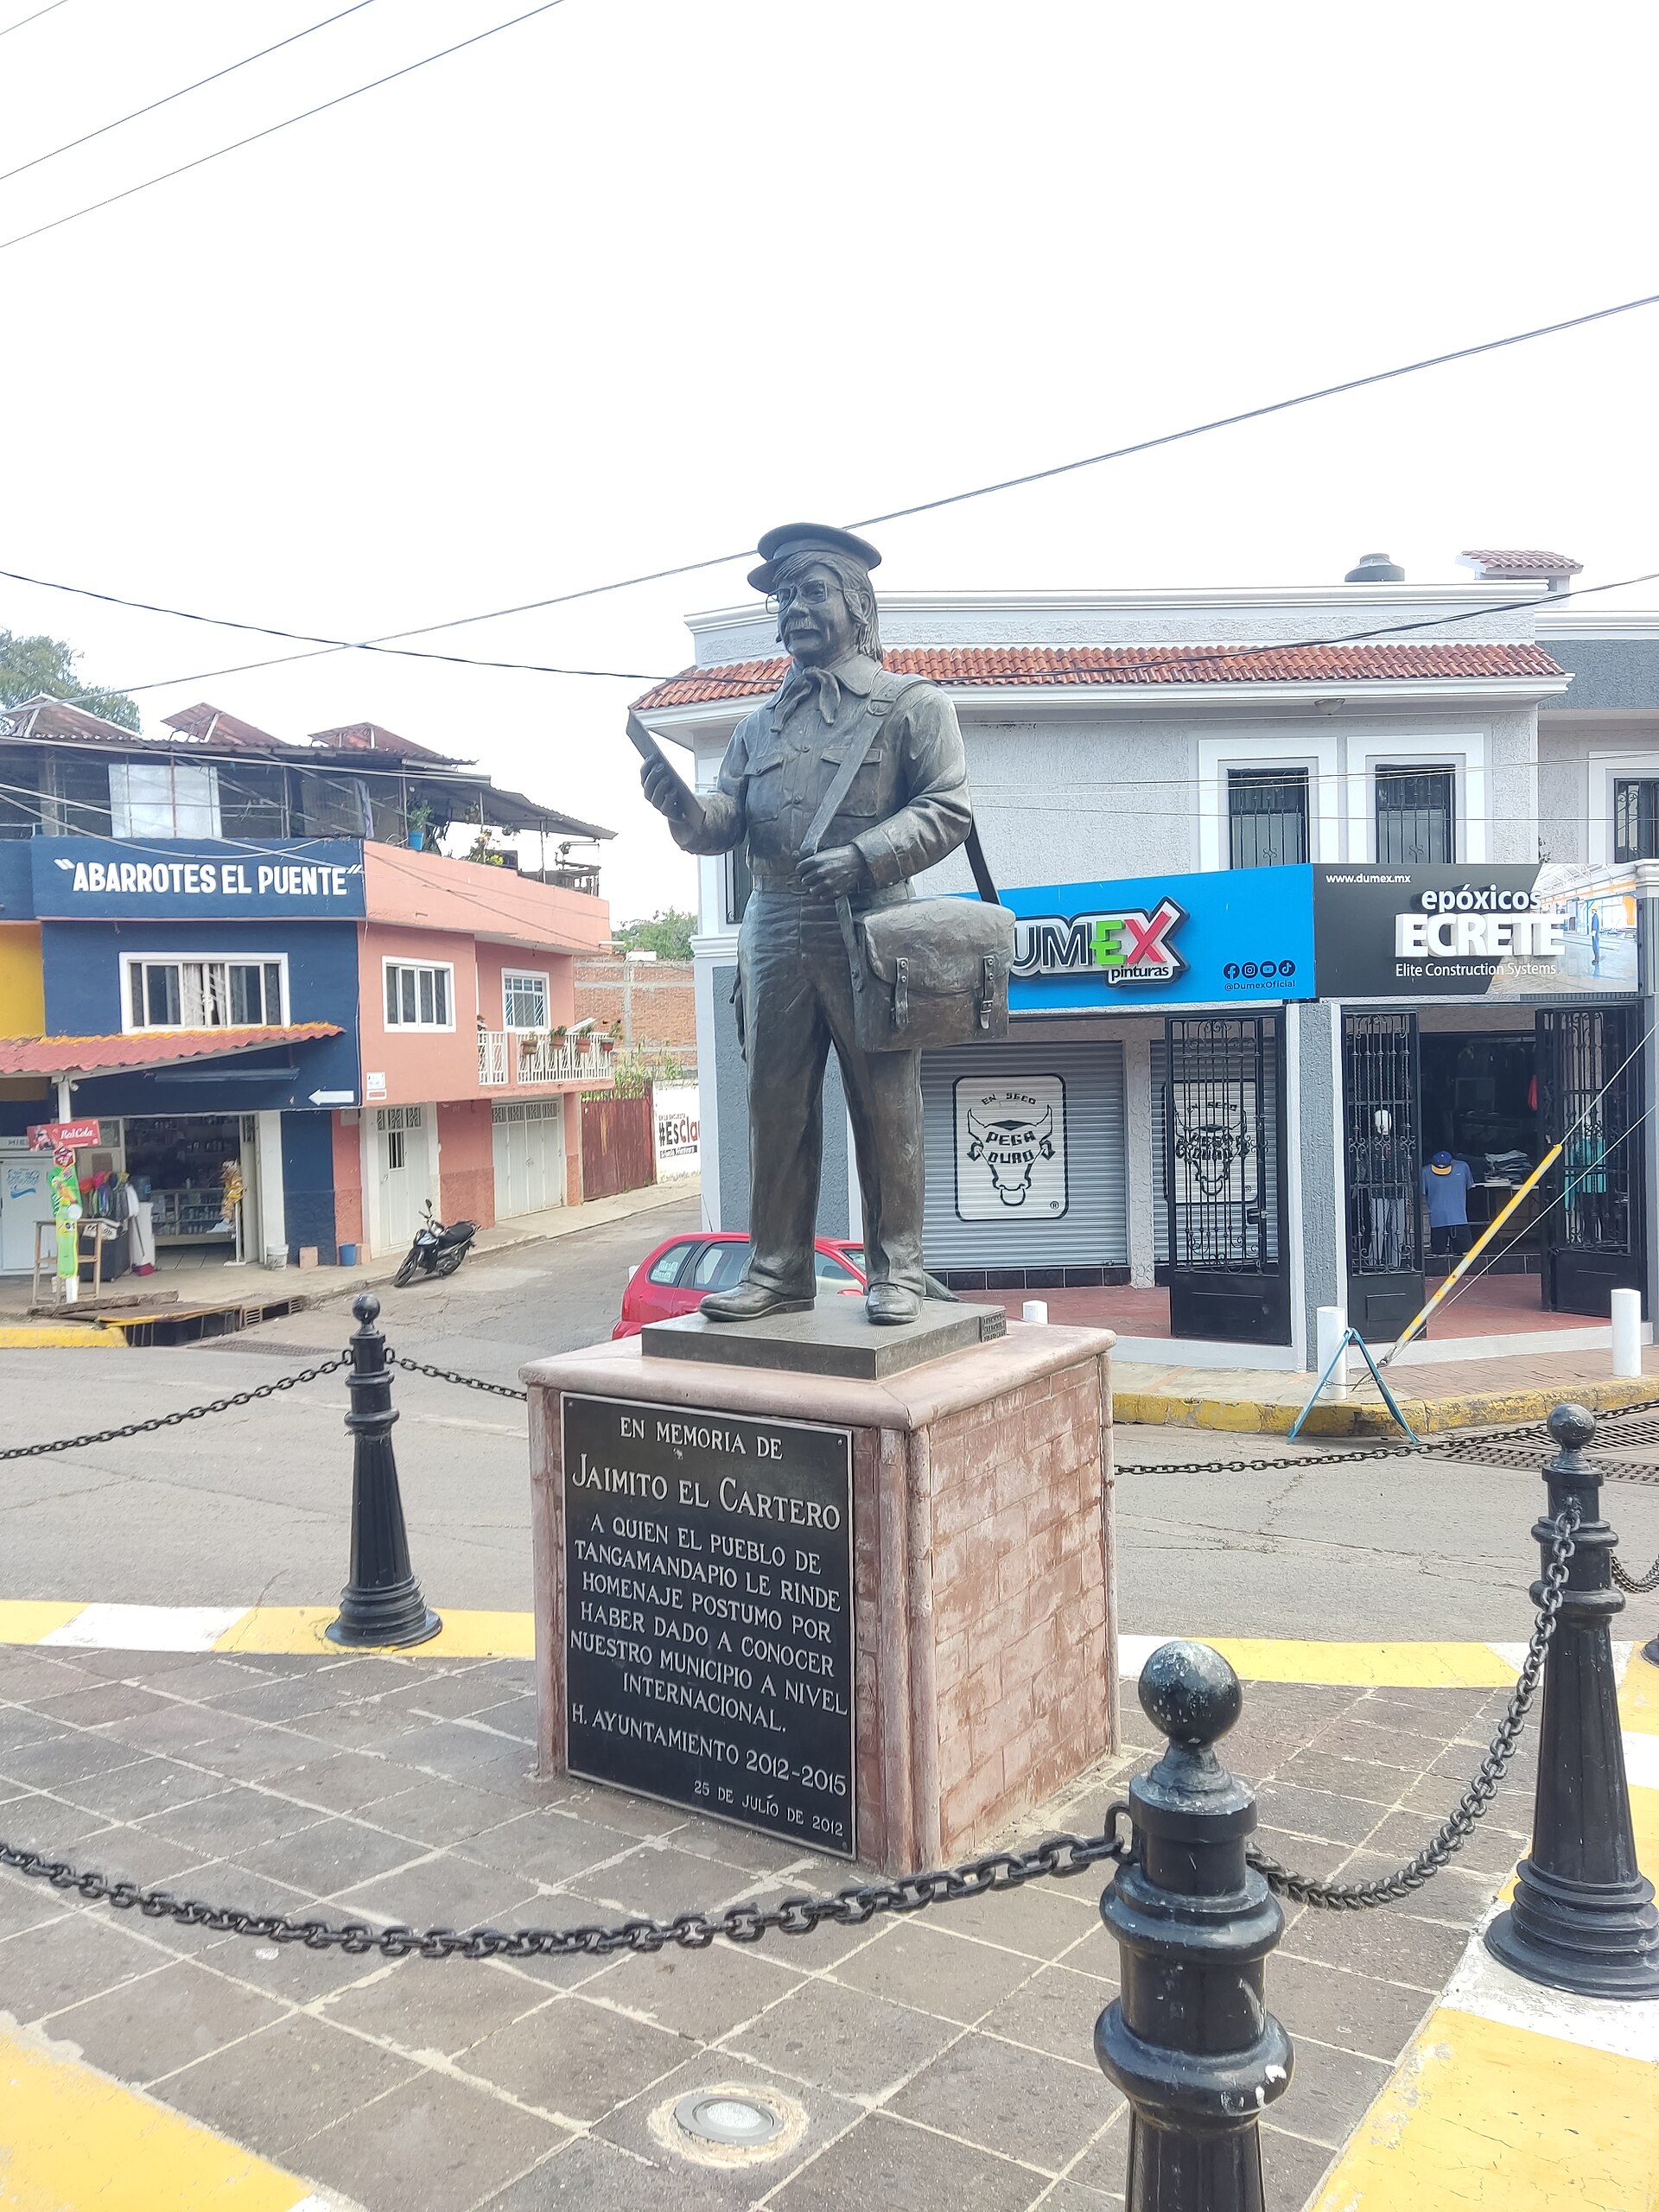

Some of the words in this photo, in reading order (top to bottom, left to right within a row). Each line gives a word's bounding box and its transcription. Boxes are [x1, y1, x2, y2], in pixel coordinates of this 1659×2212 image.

[221, 864, 252, 894] EL
[1325, 873, 1412, 884] www.dumex.mx
[1421, 883, 1541, 913] epóxicos
[1013, 910, 1173, 968] UMEX
[1395, 913, 1566, 957] ECRETE
[1110, 965, 1170, 982] pinturas
[1224, 980, 1295, 991] @DumexOficial
[1395, 963, 1423, 977] Elite
[1425, 962, 1505, 976] Construction
[1507, 962, 1556, 977] Systems
[982, 1094, 996, 1105] EN
[1006, 1092, 1037, 1105] SECO
[985, 1130, 1036, 1146] PEGA
[988, 1149, 1035, 1164] DURO
[620, 1416, 645, 1440] EN
[656, 1421, 747, 1455] MEMORIA
[756, 1435, 783, 1460] DE
[678, 1478, 709, 1509] EL
[590, 1513, 605, 1534] A
[612, 1516, 669, 1545] QUIEN
[677, 1527, 702, 1552] EL
[710, 1533, 786, 1567] PUEBLO
[795, 1549, 822, 1575] DE
[575, 1539, 738, 1589] TANGAMANDAPIO
[746, 1571, 771, 1598] LE
[780, 1579, 842, 1612] RINDE
[582, 1571, 683, 1611] HOMENAJE
[691, 1592, 782, 1631] POSTUMO
[791, 1614, 831, 1643] POR
[580, 1600, 646, 1633] HABER
[653, 1615, 709, 1647] DADO
[716, 1631, 733, 1653] A
[741, 1636, 835, 1678] CONOCER
[570, 1629, 653, 1665] NUESTRO
[660, 1649, 753, 1689] MUNICIPIO
[760, 1674, 777, 1697] A
[785, 1679, 849, 1716] NIVEL
[622, 1672, 787, 1733] INTERNACIONAL.
[571, 1702, 588, 1726] H.
[592, 1708, 740, 1766] AYUNTAMIENTO
[746, 1749, 847, 1796] 2012-2015
[694, 1780, 710, 1797] 25
[717, 1786, 735, 1805] DE
[786, 1808, 804, 1827] DE
[812, 1815, 844, 1837] 2012
